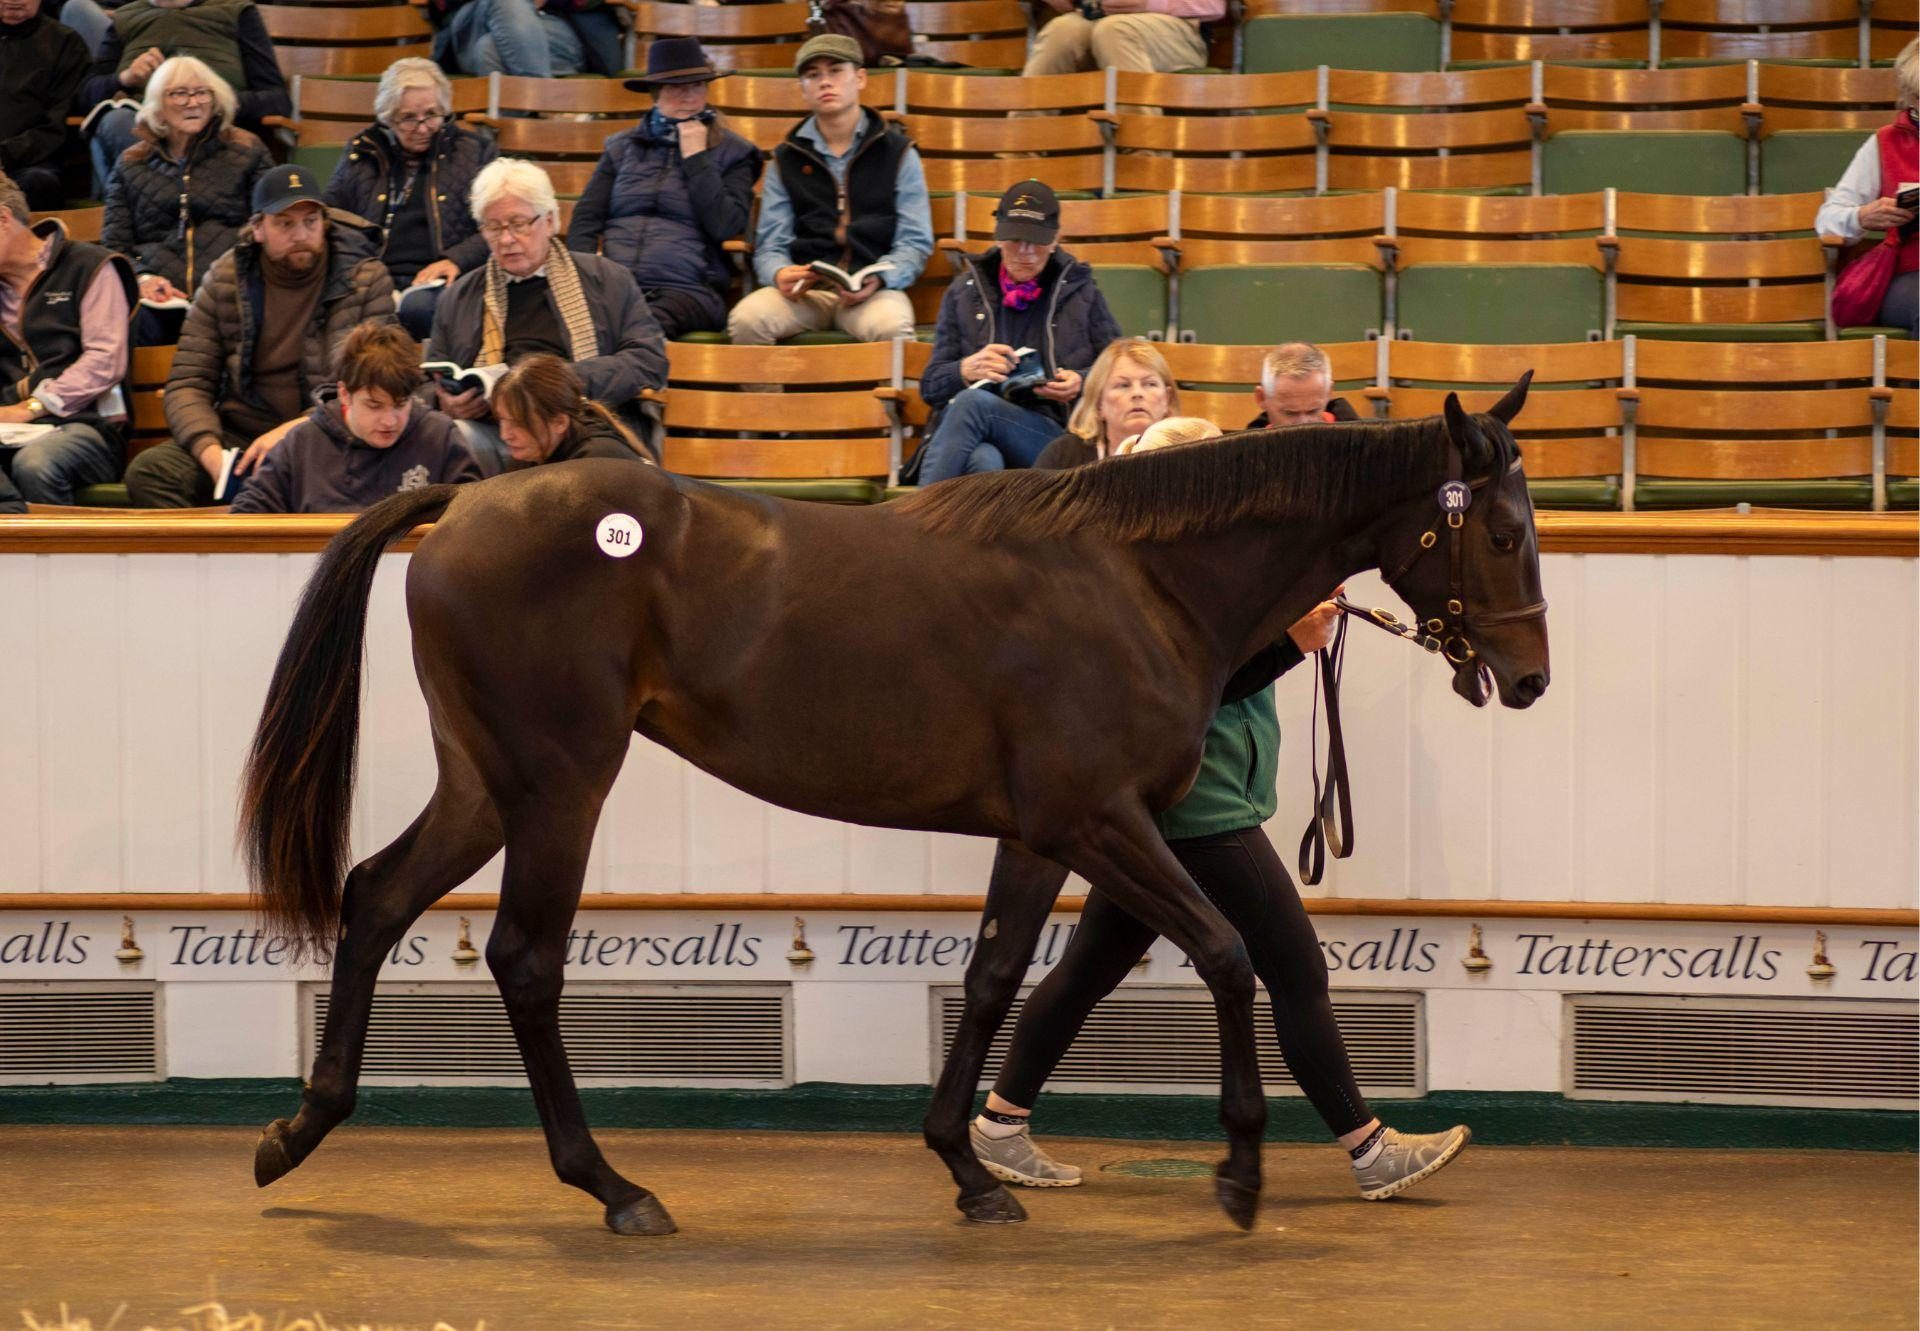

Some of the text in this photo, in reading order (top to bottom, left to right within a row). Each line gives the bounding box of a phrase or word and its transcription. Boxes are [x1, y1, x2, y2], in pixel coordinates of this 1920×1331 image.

[1445, 490, 1464, 508] 301
[606, 528, 631, 546] 301
[169, 925, 429, 966] Tattersls
[563, 923, 762, 967] ttersalls
[1515, 934, 1782, 981] Tattersalls
